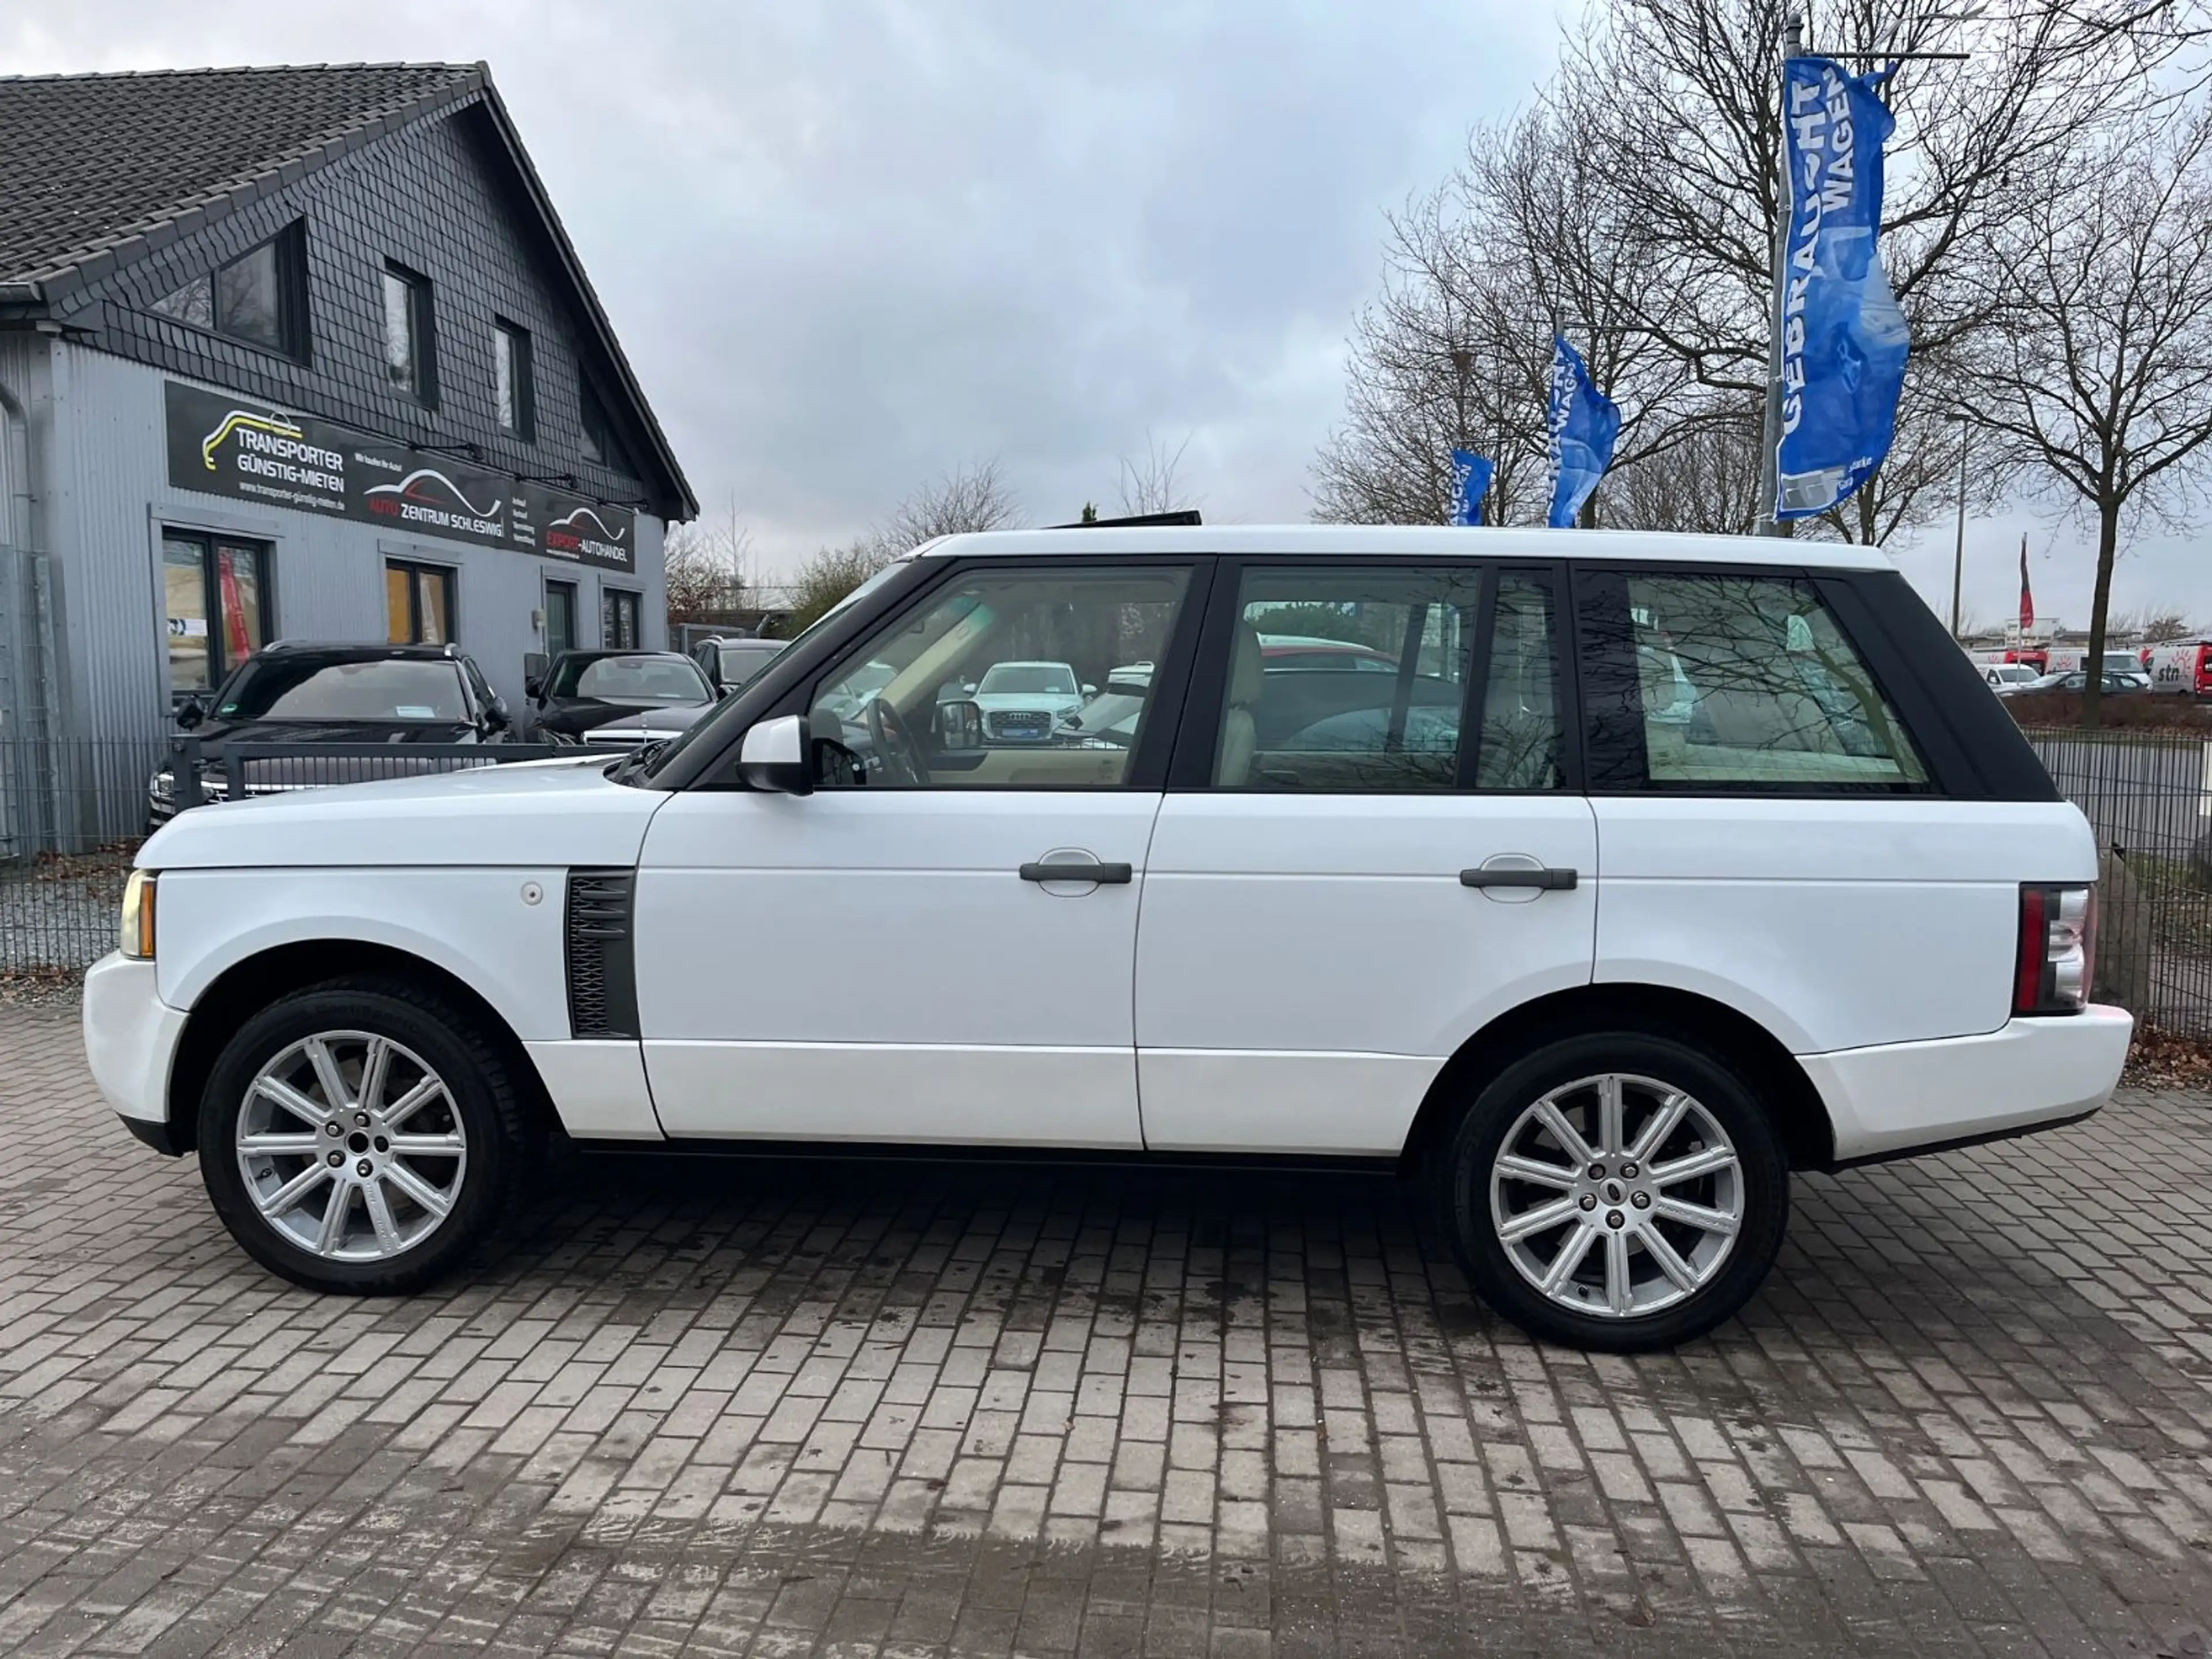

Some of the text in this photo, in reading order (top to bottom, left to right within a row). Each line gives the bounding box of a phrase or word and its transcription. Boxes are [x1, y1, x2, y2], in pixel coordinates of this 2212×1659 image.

[1821, 66, 1854, 214] WAGEN
[235, 426, 344, 472] TRANSPORTER
[237, 453, 344, 493] GÜNSTIG-MIETEN
[369, 498, 399, 516] AUTO
[401, 503, 449, 527] ZENTRUM
[450, 513, 503, 537] SCHLESWIG
[547, 530, 628, 563] EXPORT-AUTOHANDEL
